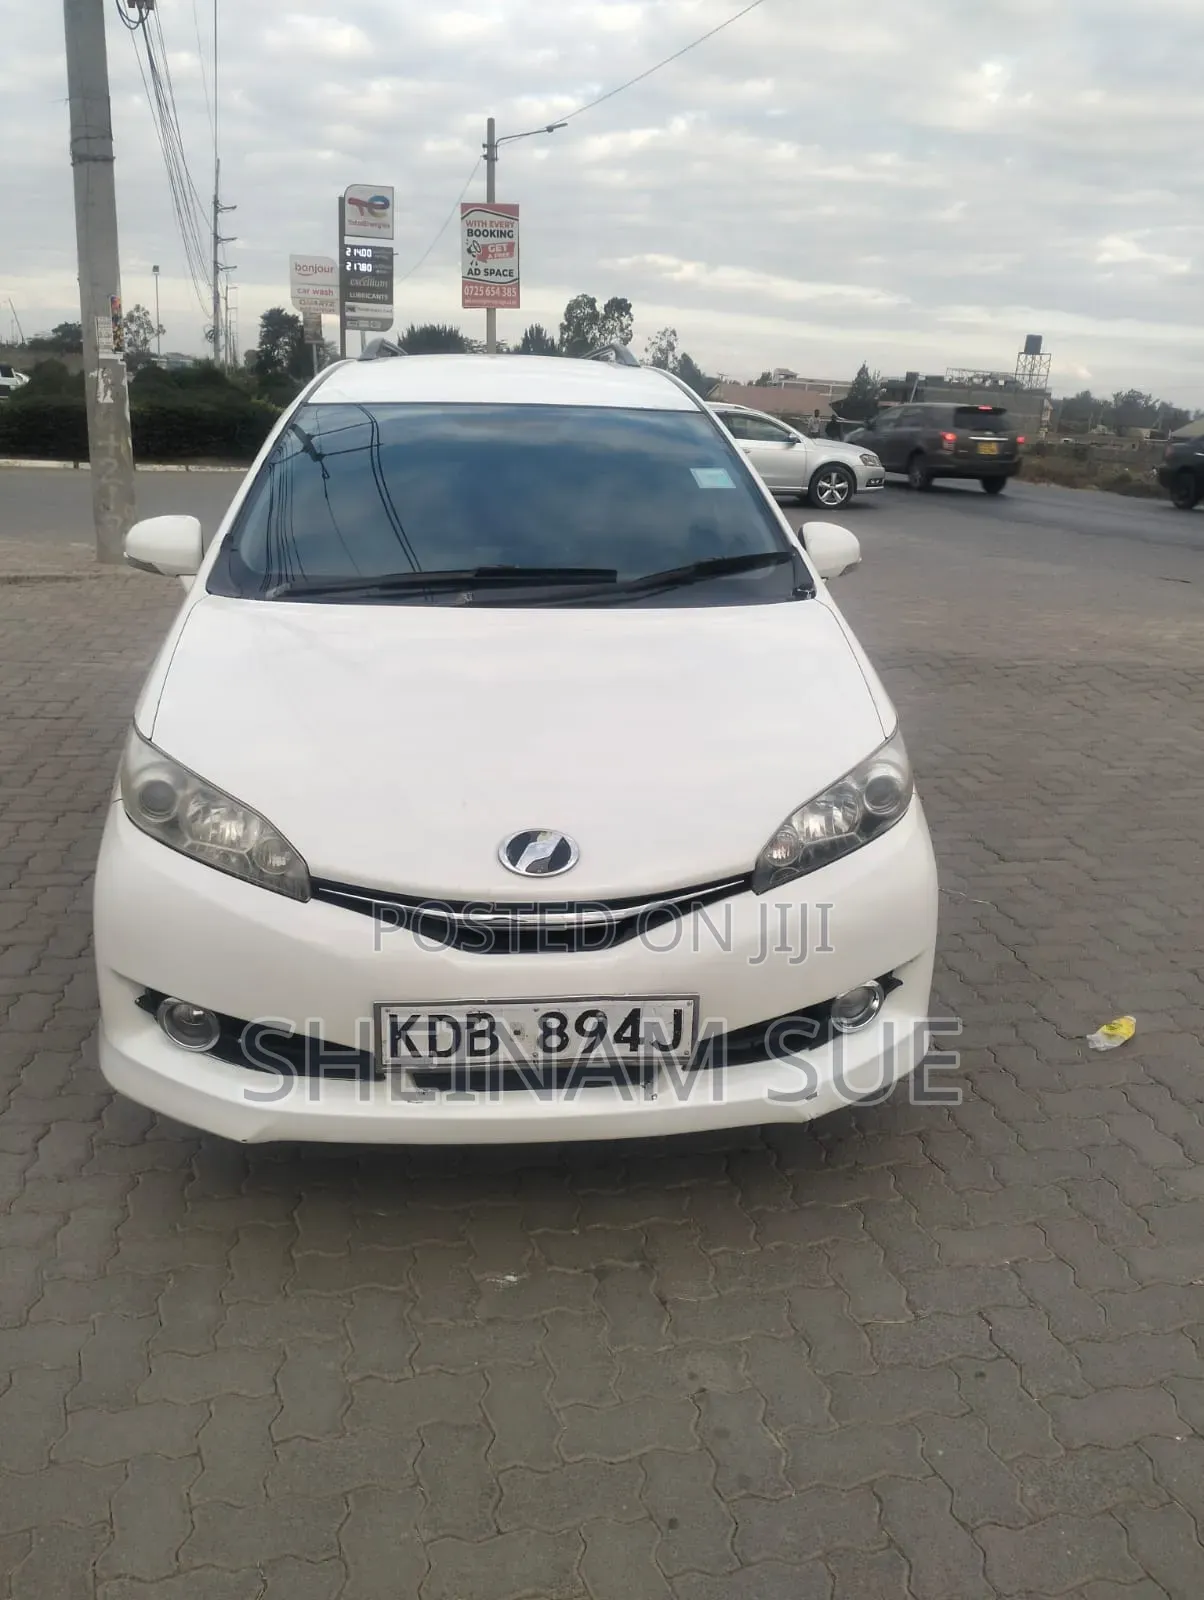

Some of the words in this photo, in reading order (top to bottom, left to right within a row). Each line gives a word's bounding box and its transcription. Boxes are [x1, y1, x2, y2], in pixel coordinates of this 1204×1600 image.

[465, 220, 487, 228] WITH
[488, 220, 515, 229] EVERY
[467, 228, 514, 239] BOOKING
[487, 244, 508, 253] GET
[294, 261, 334, 275] bonjour
[467, 267, 481, 276] AD
[483, 268, 514, 277] SPACE
[312, 288, 334, 296] wash
[464, 285, 484, 296] 0725
[485, 286, 500, 297] 654
[501, 287, 517, 297] 385
[388, 1010, 500, 1058] KDB
[537, 1007, 684, 1055] 894J
